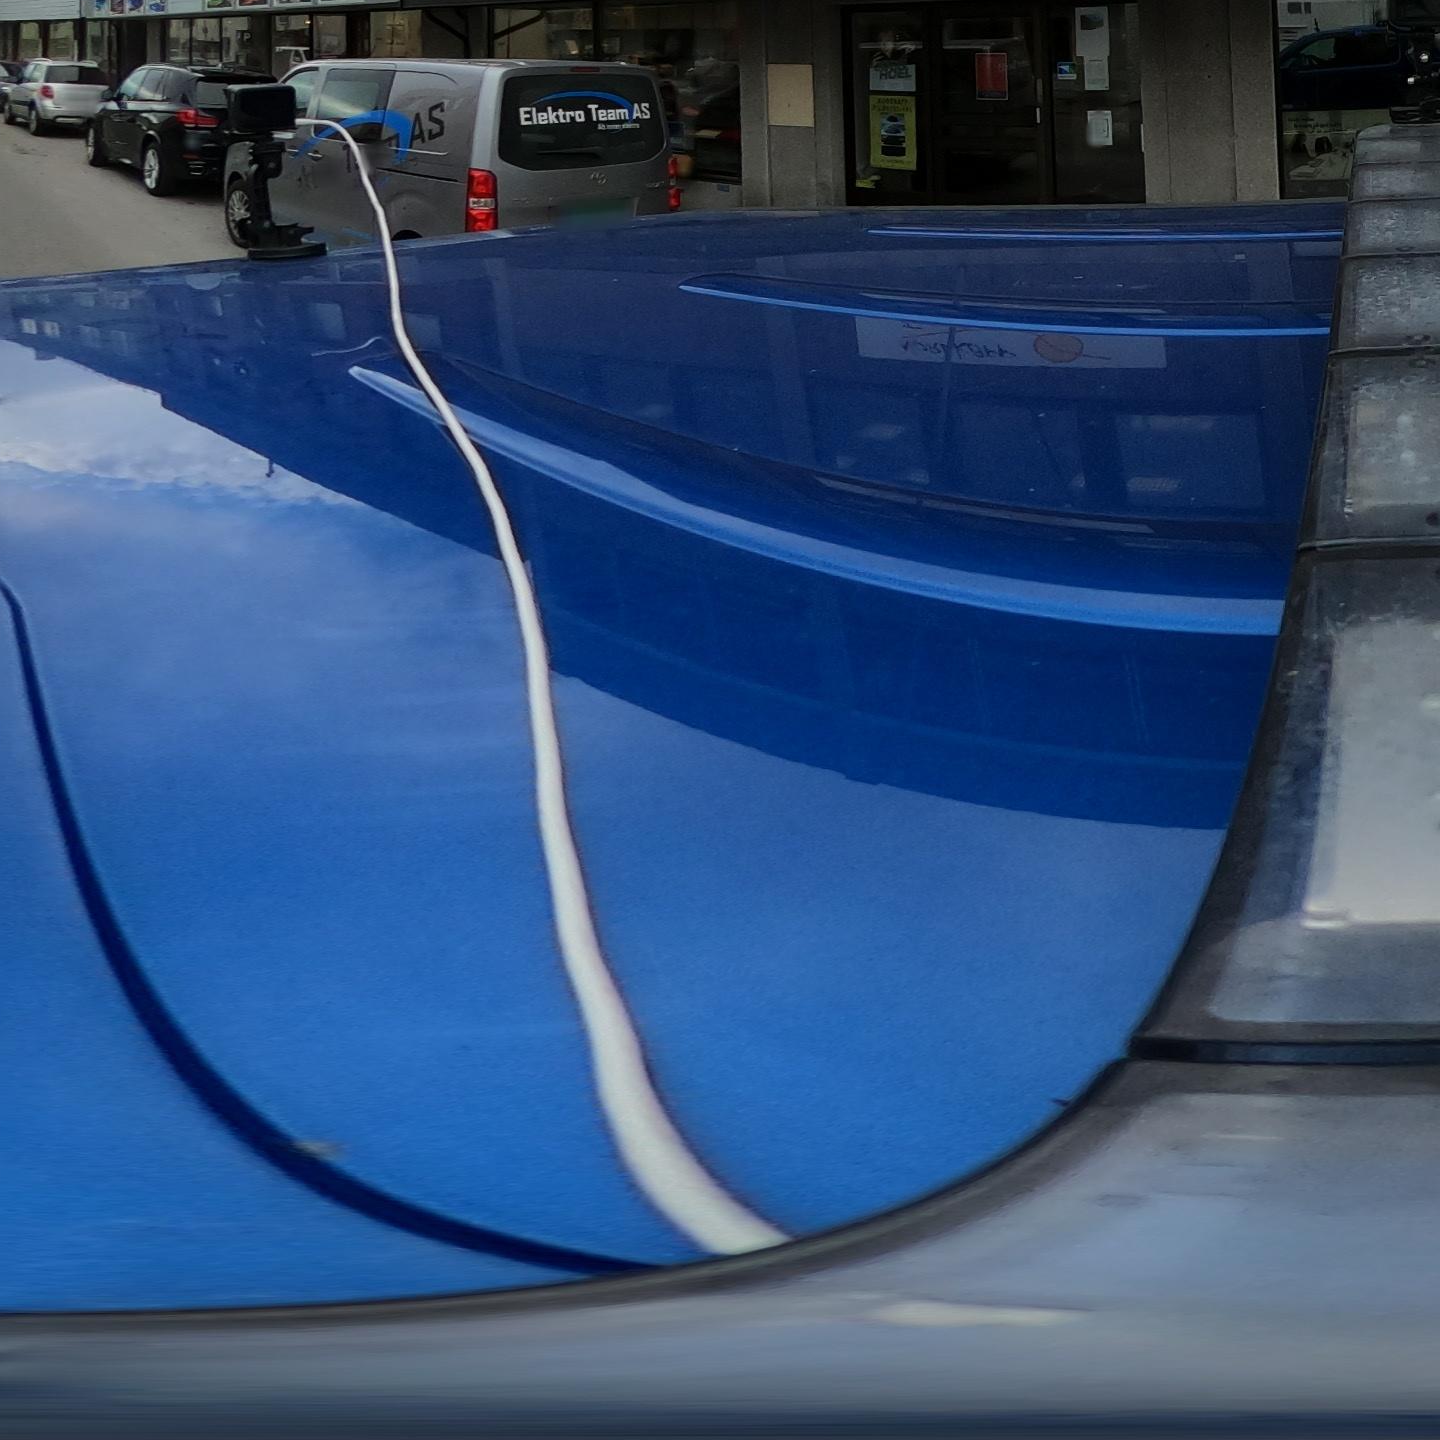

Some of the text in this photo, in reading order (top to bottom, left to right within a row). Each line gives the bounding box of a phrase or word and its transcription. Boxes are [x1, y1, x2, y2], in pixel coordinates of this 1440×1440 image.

[518, 102, 651, 126] Elektro Team AS
